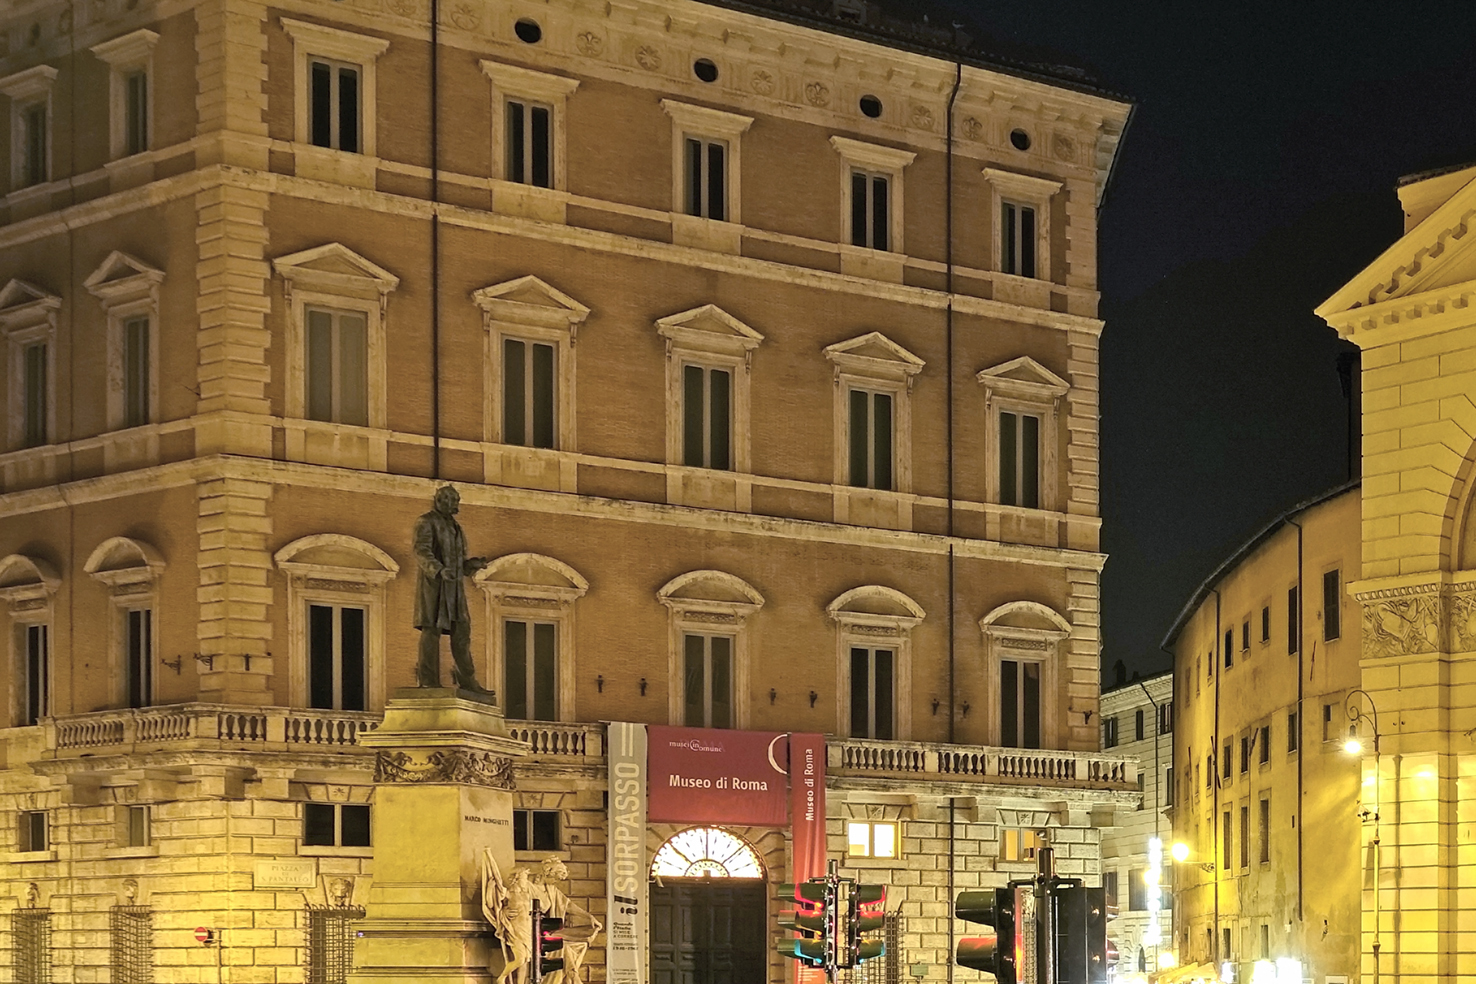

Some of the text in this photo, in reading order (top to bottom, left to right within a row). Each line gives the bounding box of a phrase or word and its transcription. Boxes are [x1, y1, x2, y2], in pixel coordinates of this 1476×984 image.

[669, 774, 768, 791] Museo di Roma
[804, 748, 814, 821] Museo di Roma
[613, 762, 640, 893] SORPASSO
[613, 895, 638, 916] il
